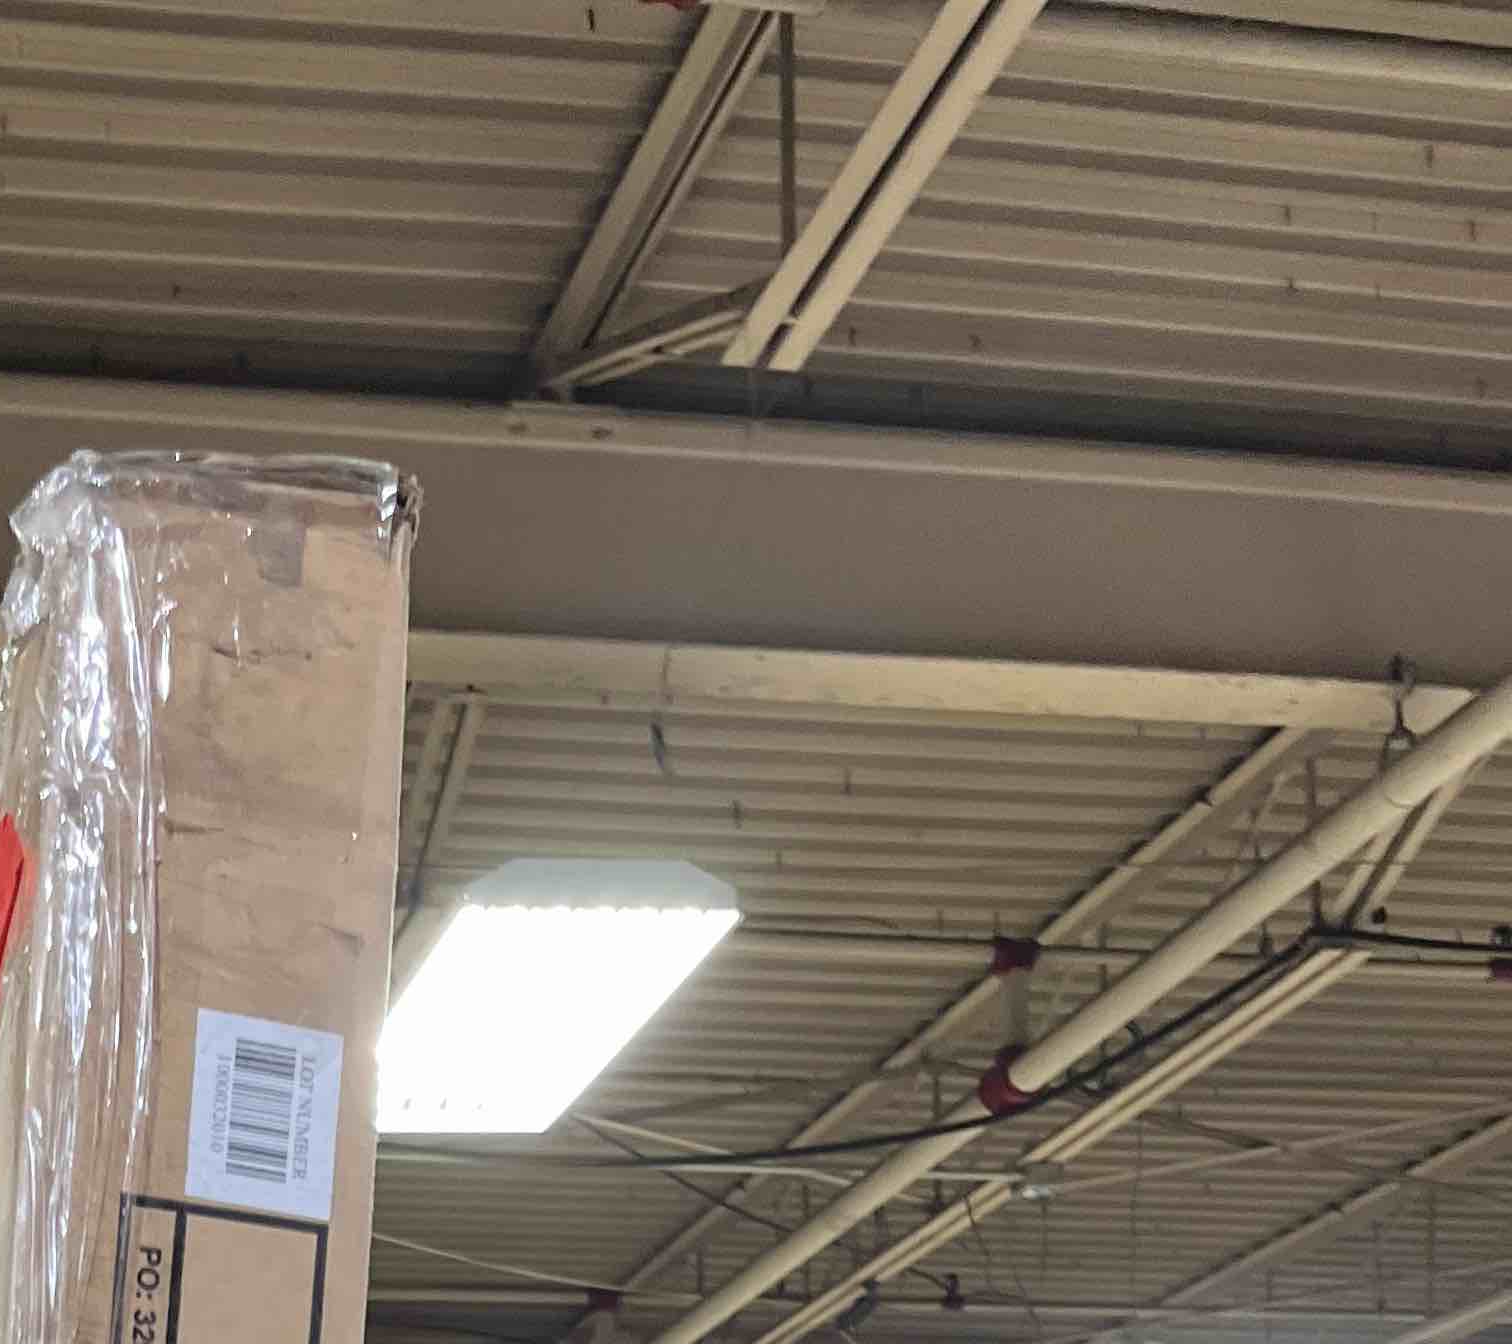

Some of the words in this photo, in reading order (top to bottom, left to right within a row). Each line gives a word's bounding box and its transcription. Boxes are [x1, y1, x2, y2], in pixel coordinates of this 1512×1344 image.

[299, 1056, 317, 1093] LOT
[291, 1096, 314, 1180] NUMBER
[135, 1246, 162, 1300] PO:
